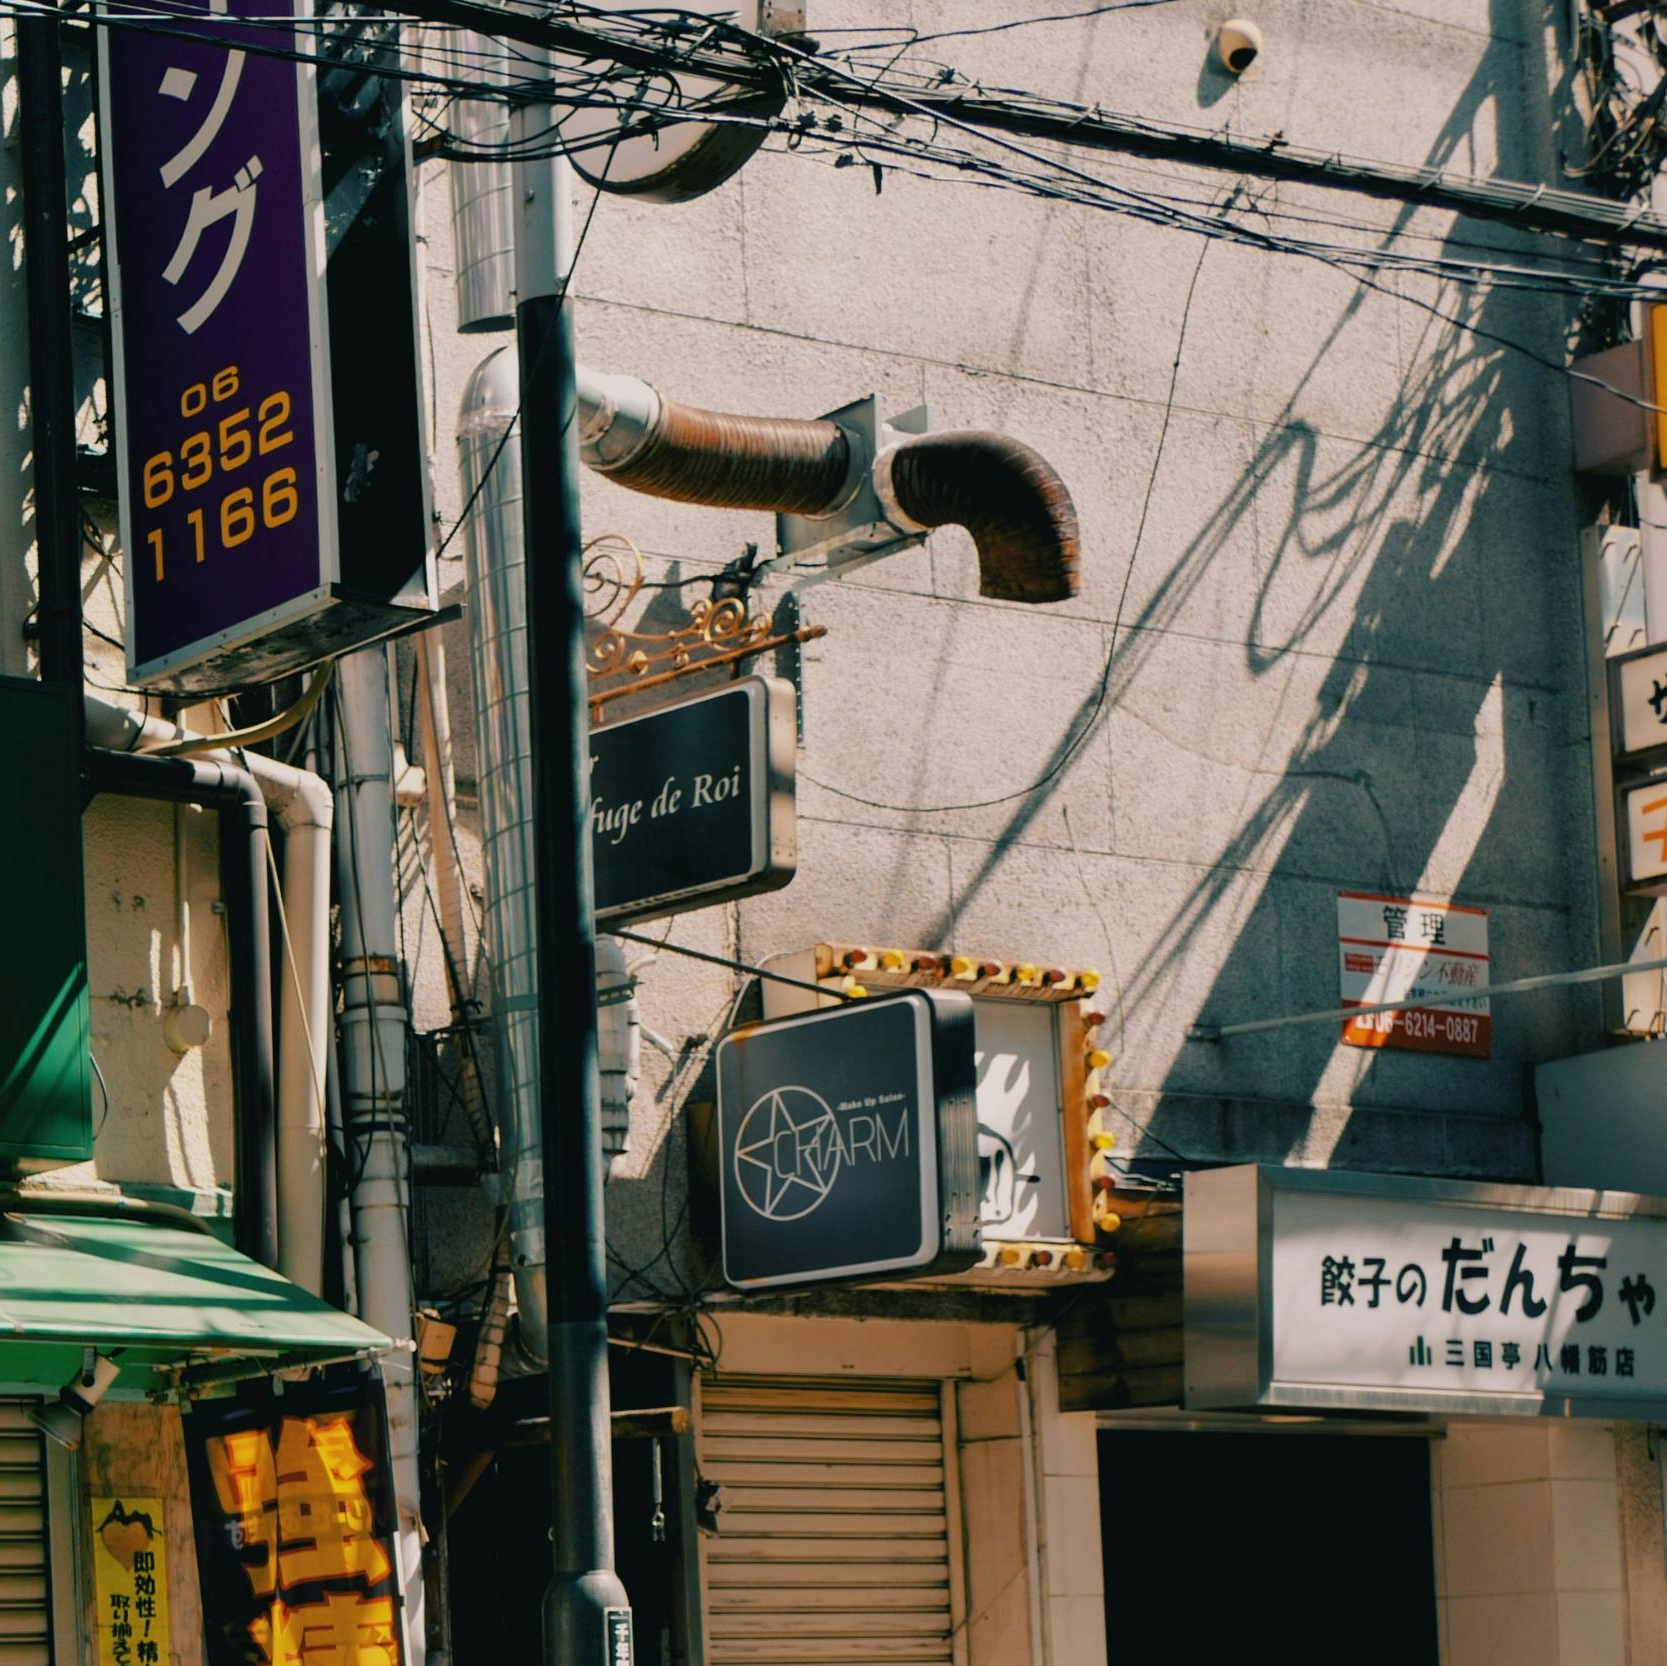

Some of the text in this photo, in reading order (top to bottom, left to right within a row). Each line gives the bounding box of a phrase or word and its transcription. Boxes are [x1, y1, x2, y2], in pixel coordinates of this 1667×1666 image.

[158, 0, 264, 335] ング
[181, 366, 239, 418] 06
[144, 391, 294, 510] 6352
[147, 467, 298, 583] 1166
[589, 765, 741, 845] fuge de Roi
[1382, 905, 1446, 946] 管理
[773, 1107, 910, 1179] CHARM
